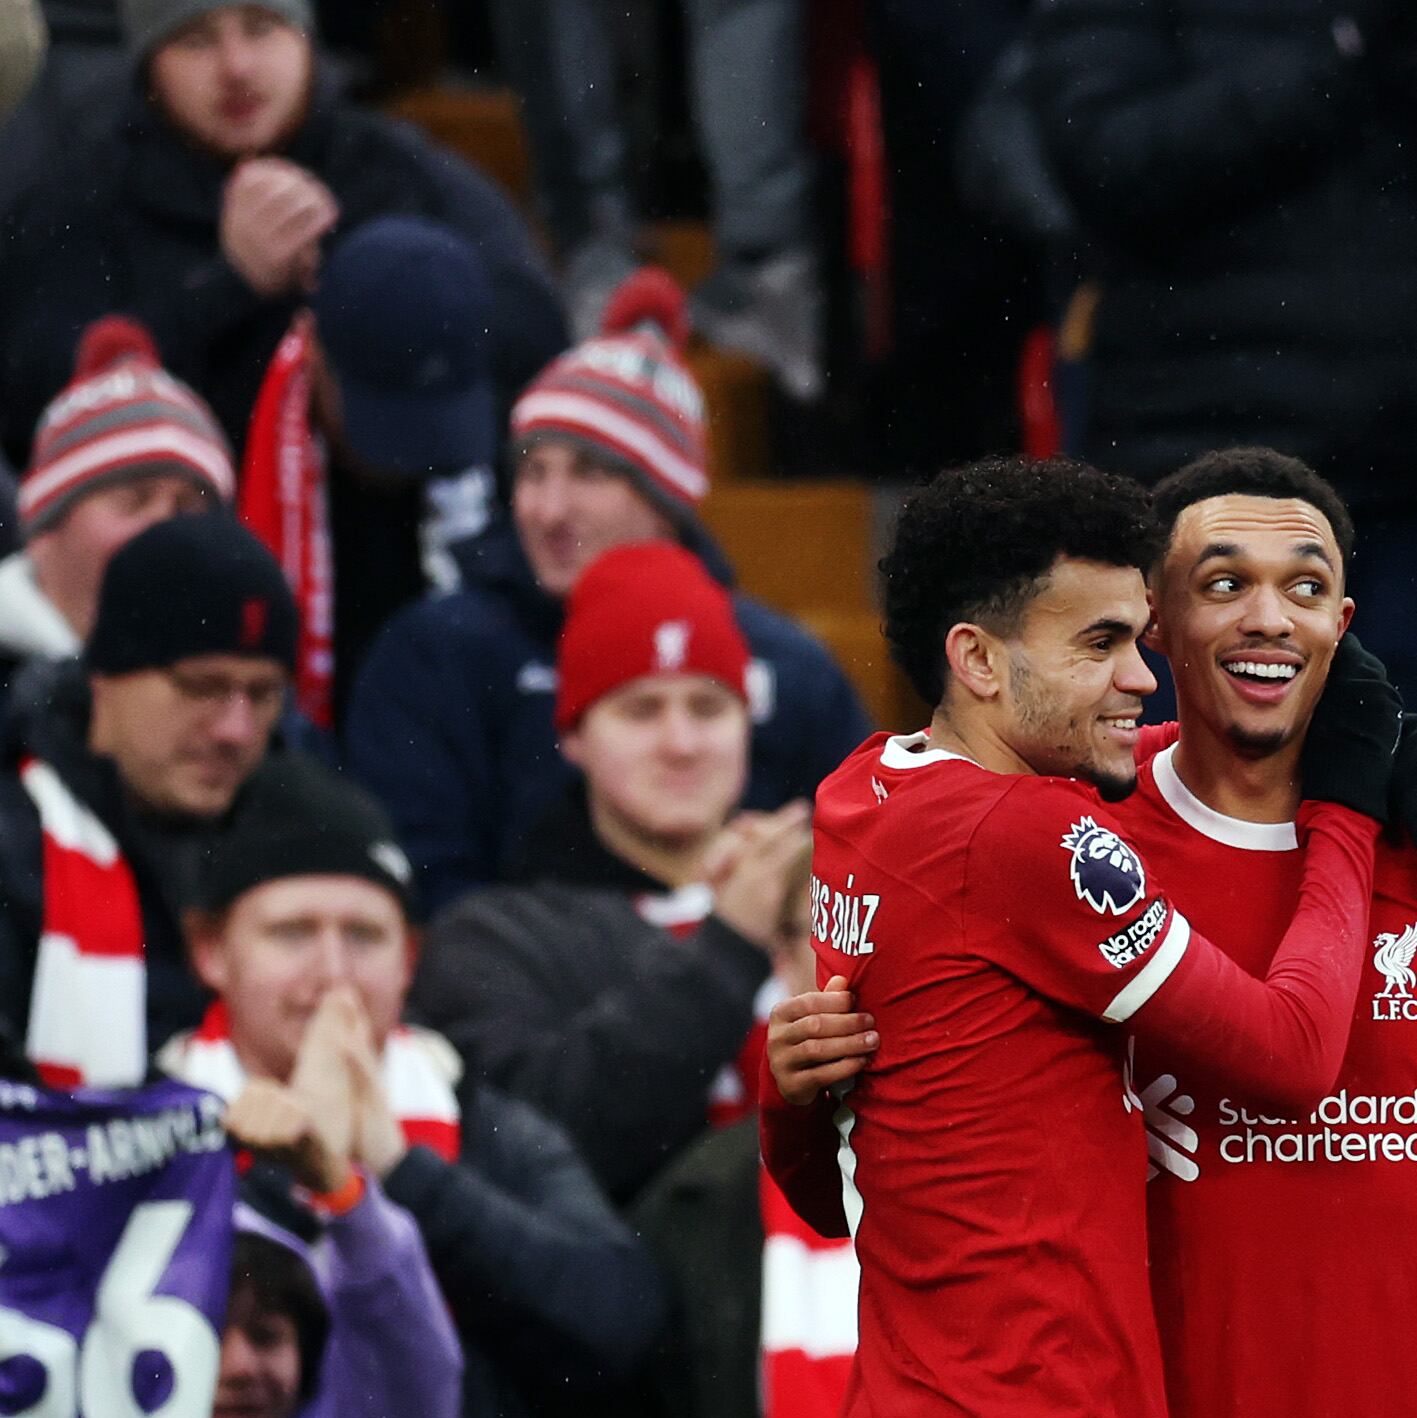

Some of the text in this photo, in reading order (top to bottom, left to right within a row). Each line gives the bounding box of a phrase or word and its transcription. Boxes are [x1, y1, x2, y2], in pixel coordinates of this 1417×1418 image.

[831, 873, 880, 957] DÍAZ
[1098, 900, 1164, 961] No room
